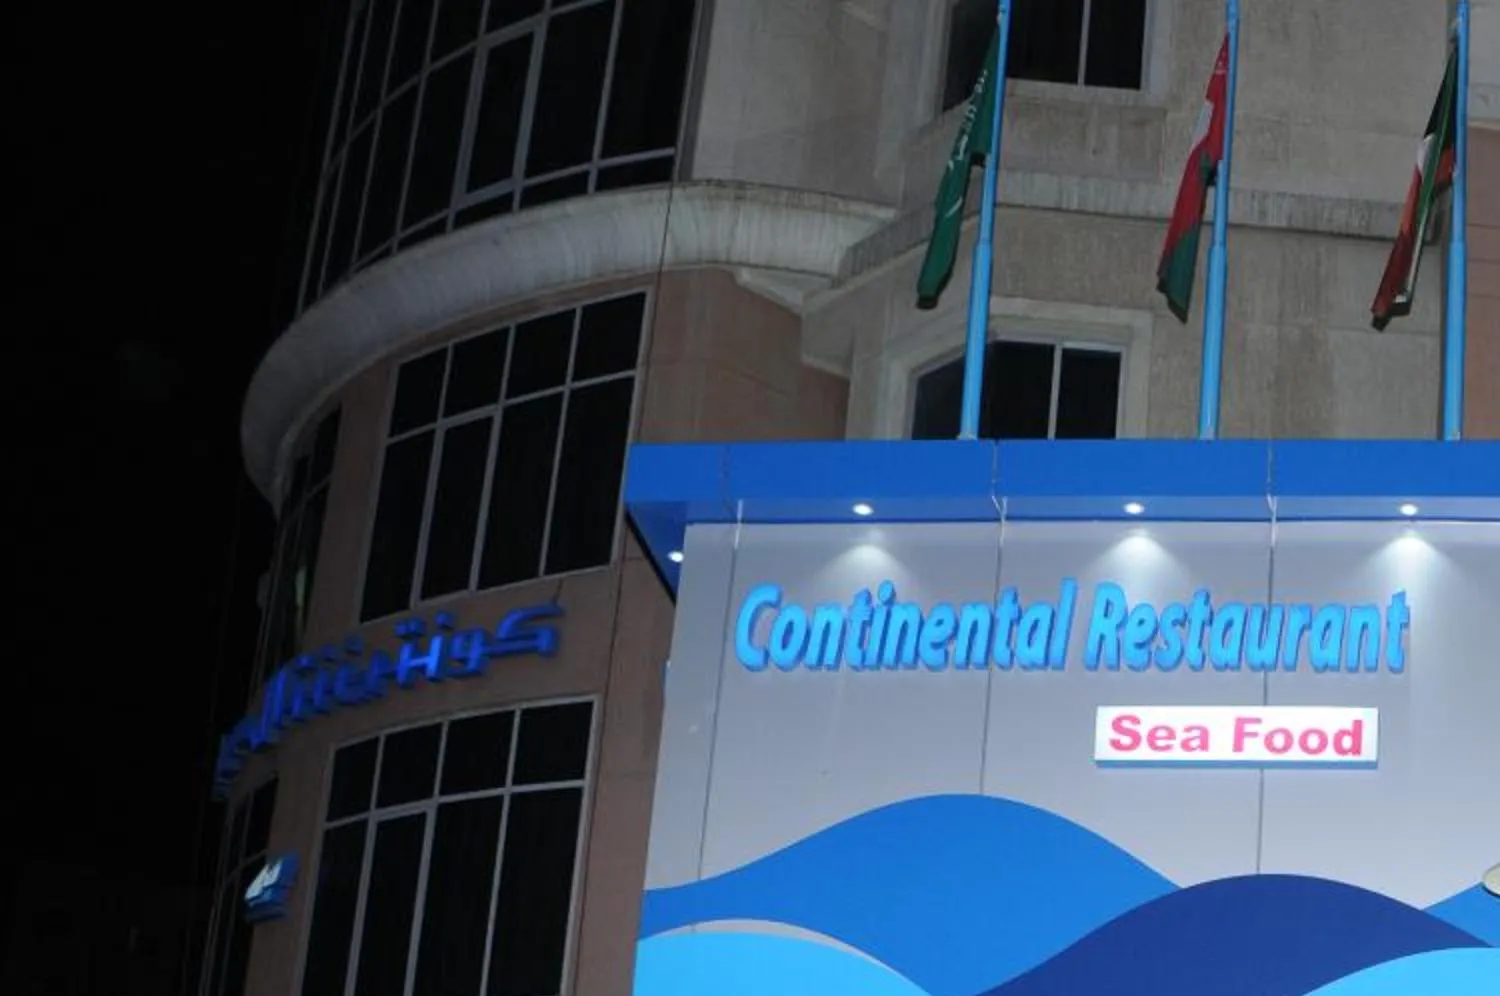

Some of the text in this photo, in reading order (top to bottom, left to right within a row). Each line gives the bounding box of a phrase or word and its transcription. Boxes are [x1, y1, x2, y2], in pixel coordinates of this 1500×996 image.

[735, 578, 1411, 673] Continental Restaurant
[1109, 715, 1363, 757] Sea Food
